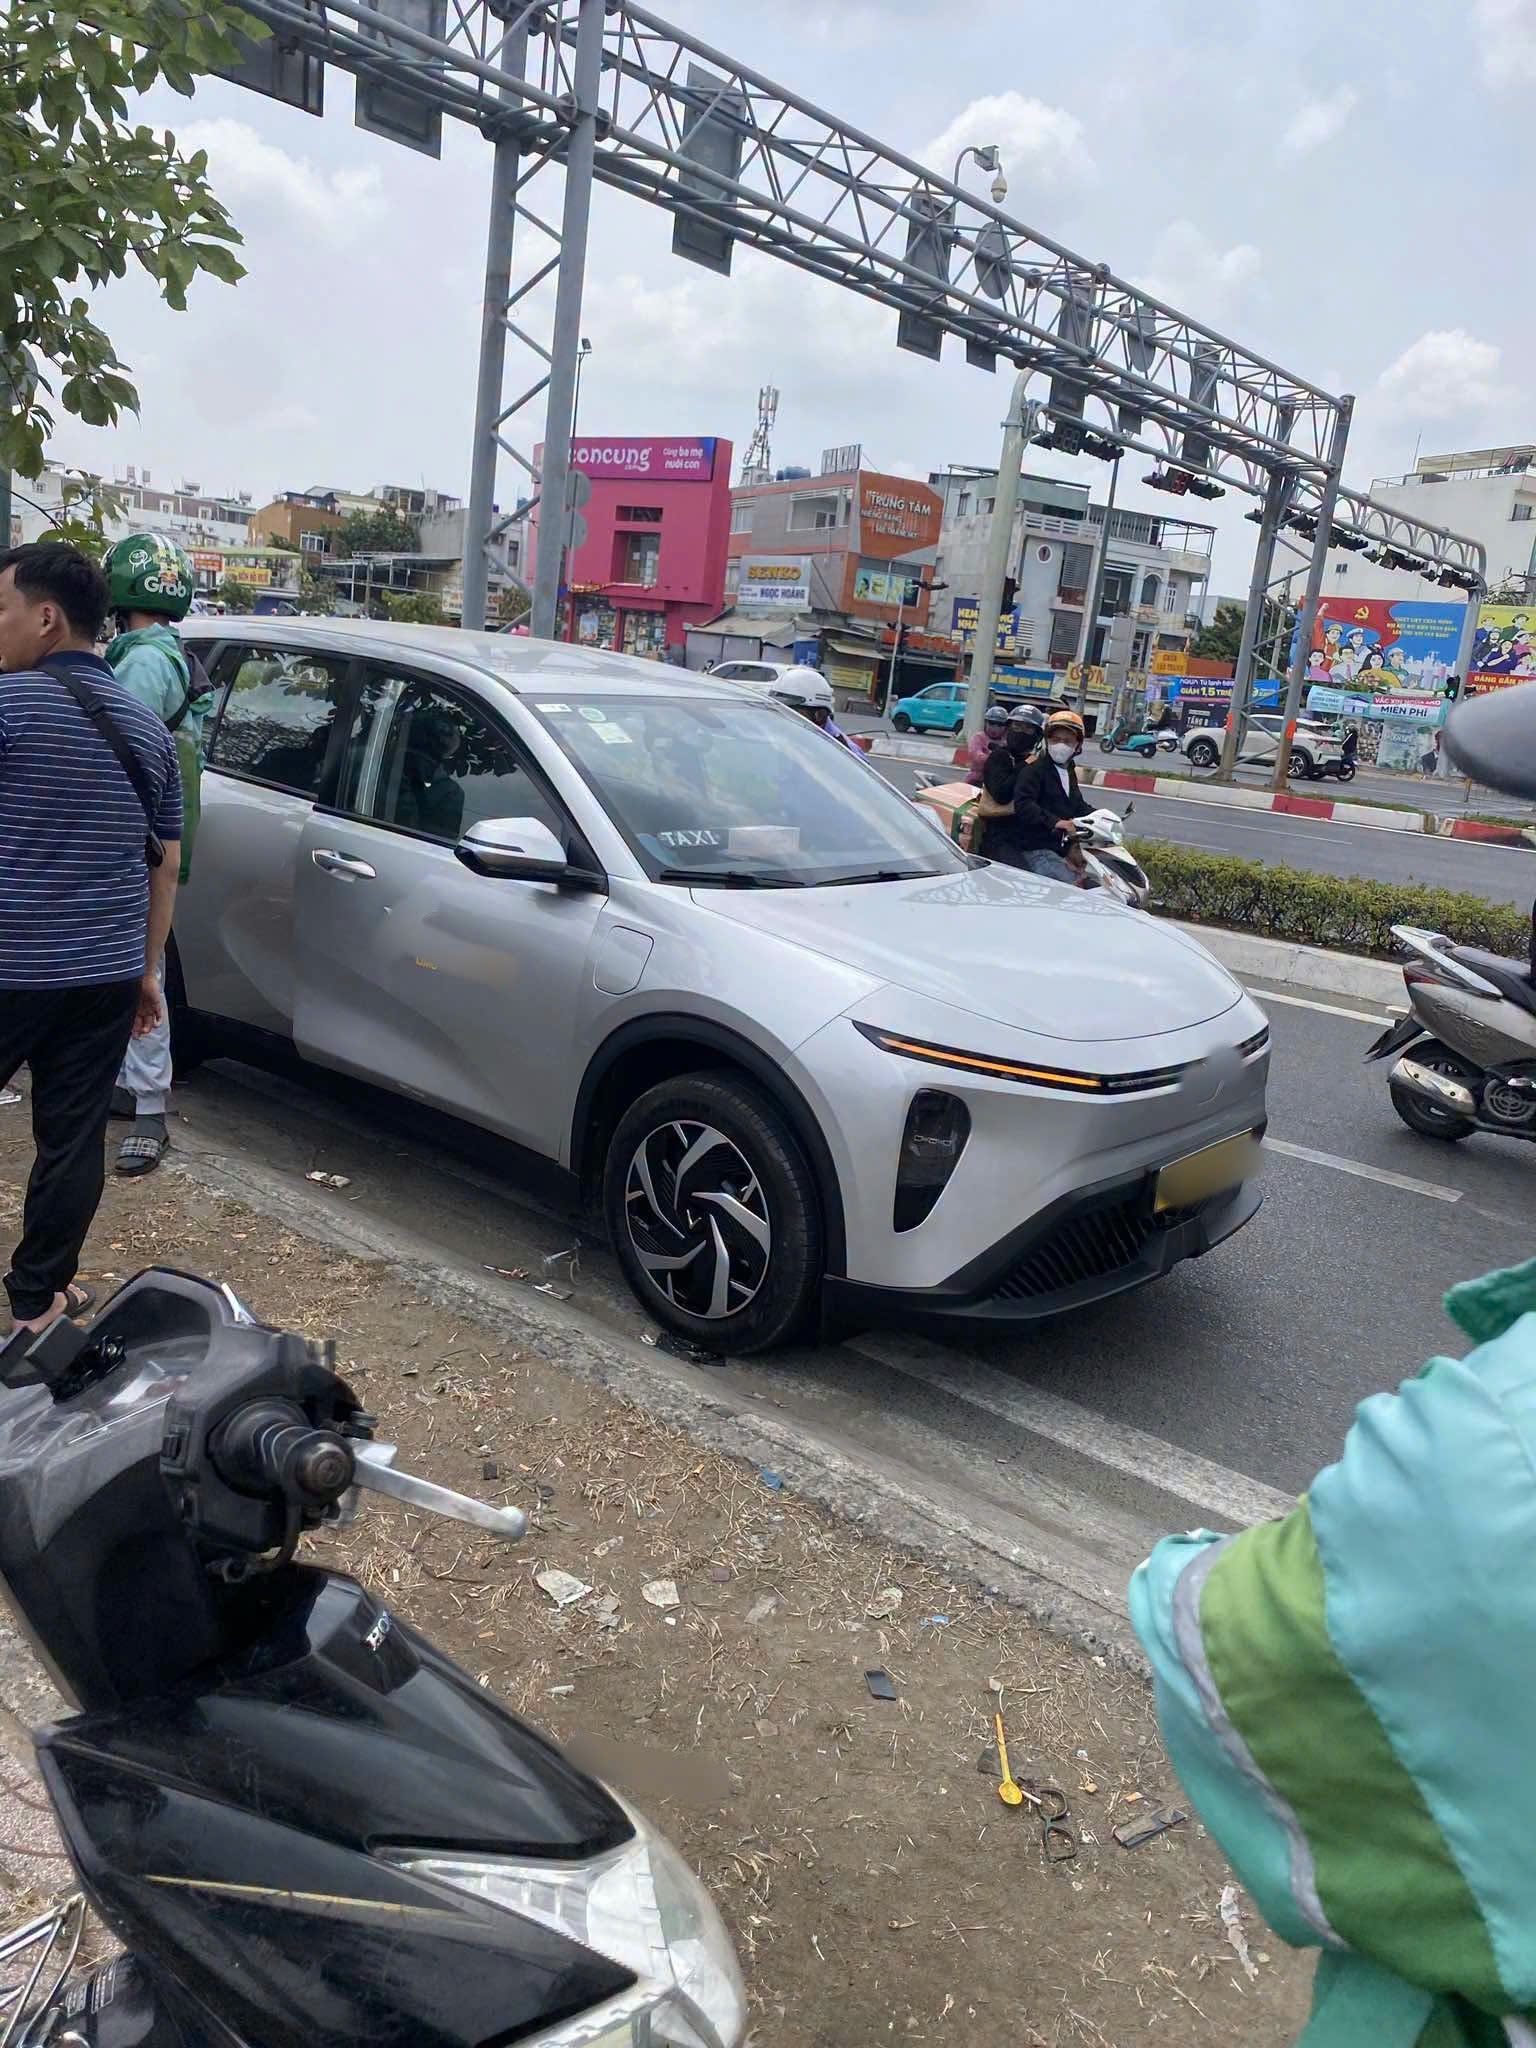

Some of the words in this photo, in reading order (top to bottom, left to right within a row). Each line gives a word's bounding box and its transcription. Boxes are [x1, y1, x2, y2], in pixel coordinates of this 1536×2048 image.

[872, 495, 905, 510] TRUNG
[909, 501, 931, 515] TÂM
[144, 576, 187, 598] Grab
[661, 830, 719, 847] TAXI
